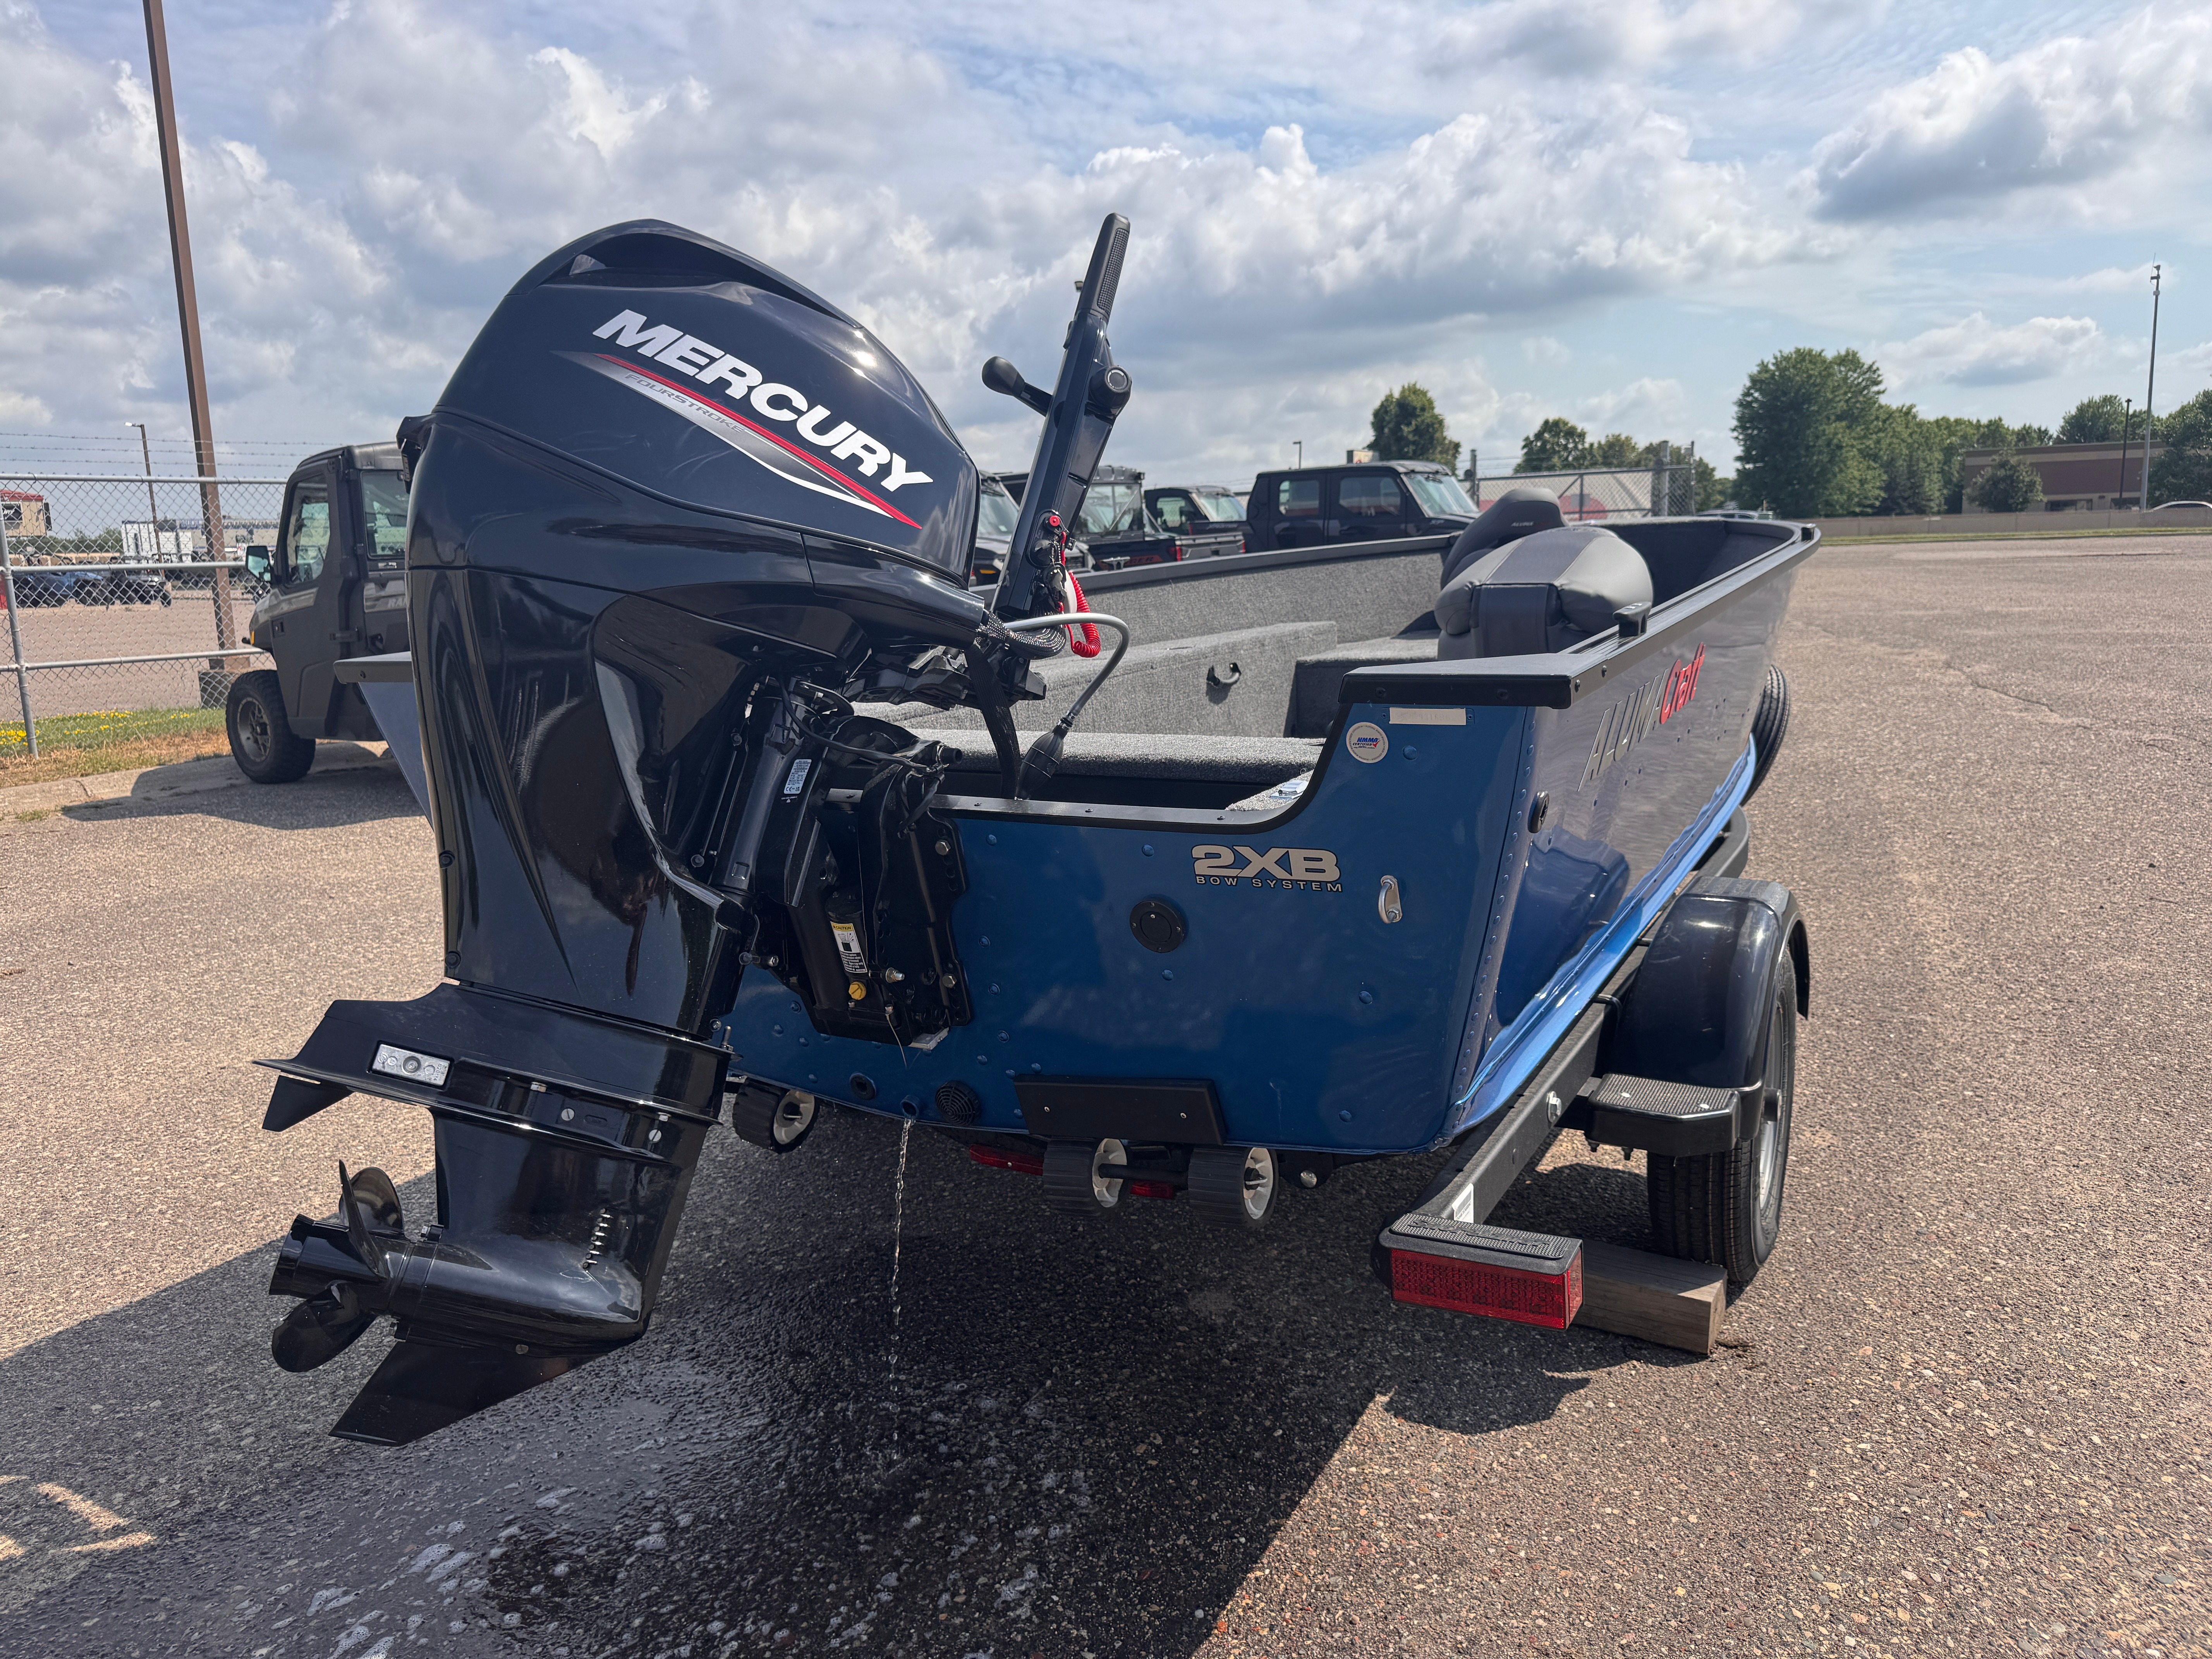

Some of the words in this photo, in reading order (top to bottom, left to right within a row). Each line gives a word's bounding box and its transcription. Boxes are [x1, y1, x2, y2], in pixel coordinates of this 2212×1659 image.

[592, 309, 933, 492] MERCURY
[625, 374, 745, 433] FOURSTROKE
[1192, 845, 1340, 882] 2XB
[1196, 876, 1238, 886] BOW
[1252, 879, 1342, 891] SYSTEM
